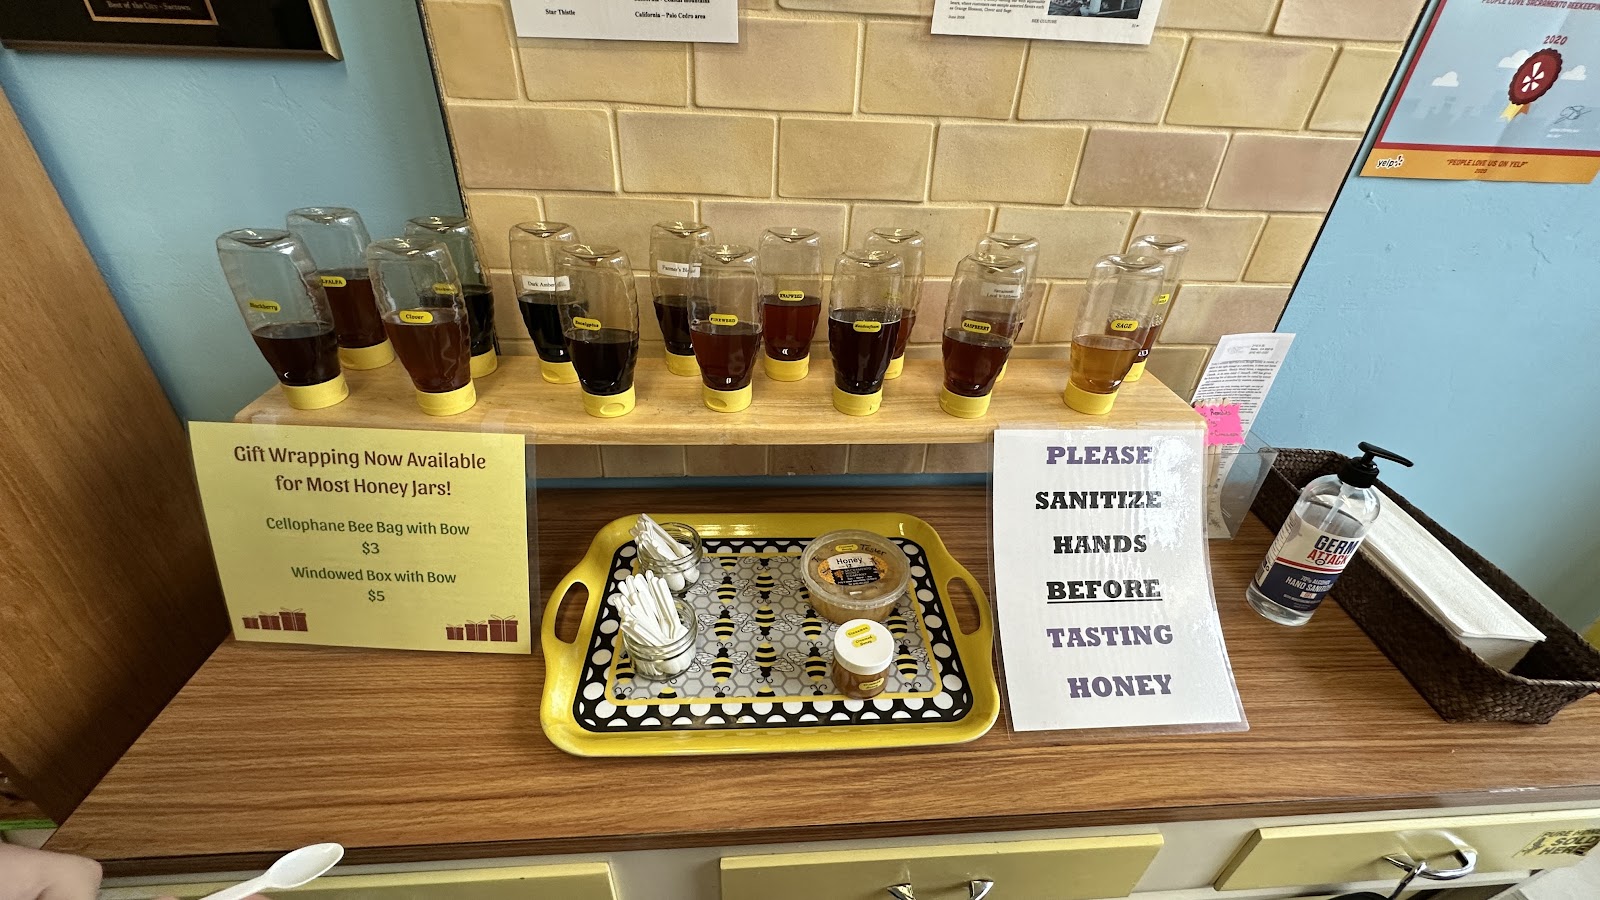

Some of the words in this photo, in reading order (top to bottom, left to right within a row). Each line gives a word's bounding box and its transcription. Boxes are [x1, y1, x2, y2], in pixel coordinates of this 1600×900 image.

[1543, 35, 1568, 45] 2020
[1377, 158, 1394, 167] yelp
[234, 446, 265, 462] Gift
[268, 447, 360, 468] Wrapping
[364, 450, 403, 467] Now
[407, 451, 486, 469] Available
[1046, 446, 1153, 465] PLEASE
[276, 475, 302, 491] for
[307, 477, 349, 493] Most
[354, 478, 408, 498] Honey
[412, 480, 451, 498] Jars!
[1035, 491, 1162, 510] SANITIZE
[266, 517, 345, 534] Cellophane
[348, 520, 374, 533] Bee
[376, 521, 403, 536] Bag
[406, 522, 437, 534] with
[440, 522, 470, 536] Bow
[362, 541, 380, 555] $3
[860, 544, 887, 556] Tester
[1053, 534, 1148, 554] HANDS
[1314, 534, 1359, 555] GERM
[836, 557, 863, 565] Honey
[1307, 549, 1348, 565] ATTACK
[291, 566, 363, 581] Windowed
[367, 569, 392, 582] Box
[394, 570, 424, 583] with
[427, 571, 457, 584] Bow
[1285, 576, 1306, 590] HAND
[368, 589, 385, 602] $5
[1046, 579, 1162, 602] BEFORE
[1046, 624, 1174, 648] TASTING
[1067, 674, 1172, 698] HONEY
[1551, 836, 1600, 846] SOLD
